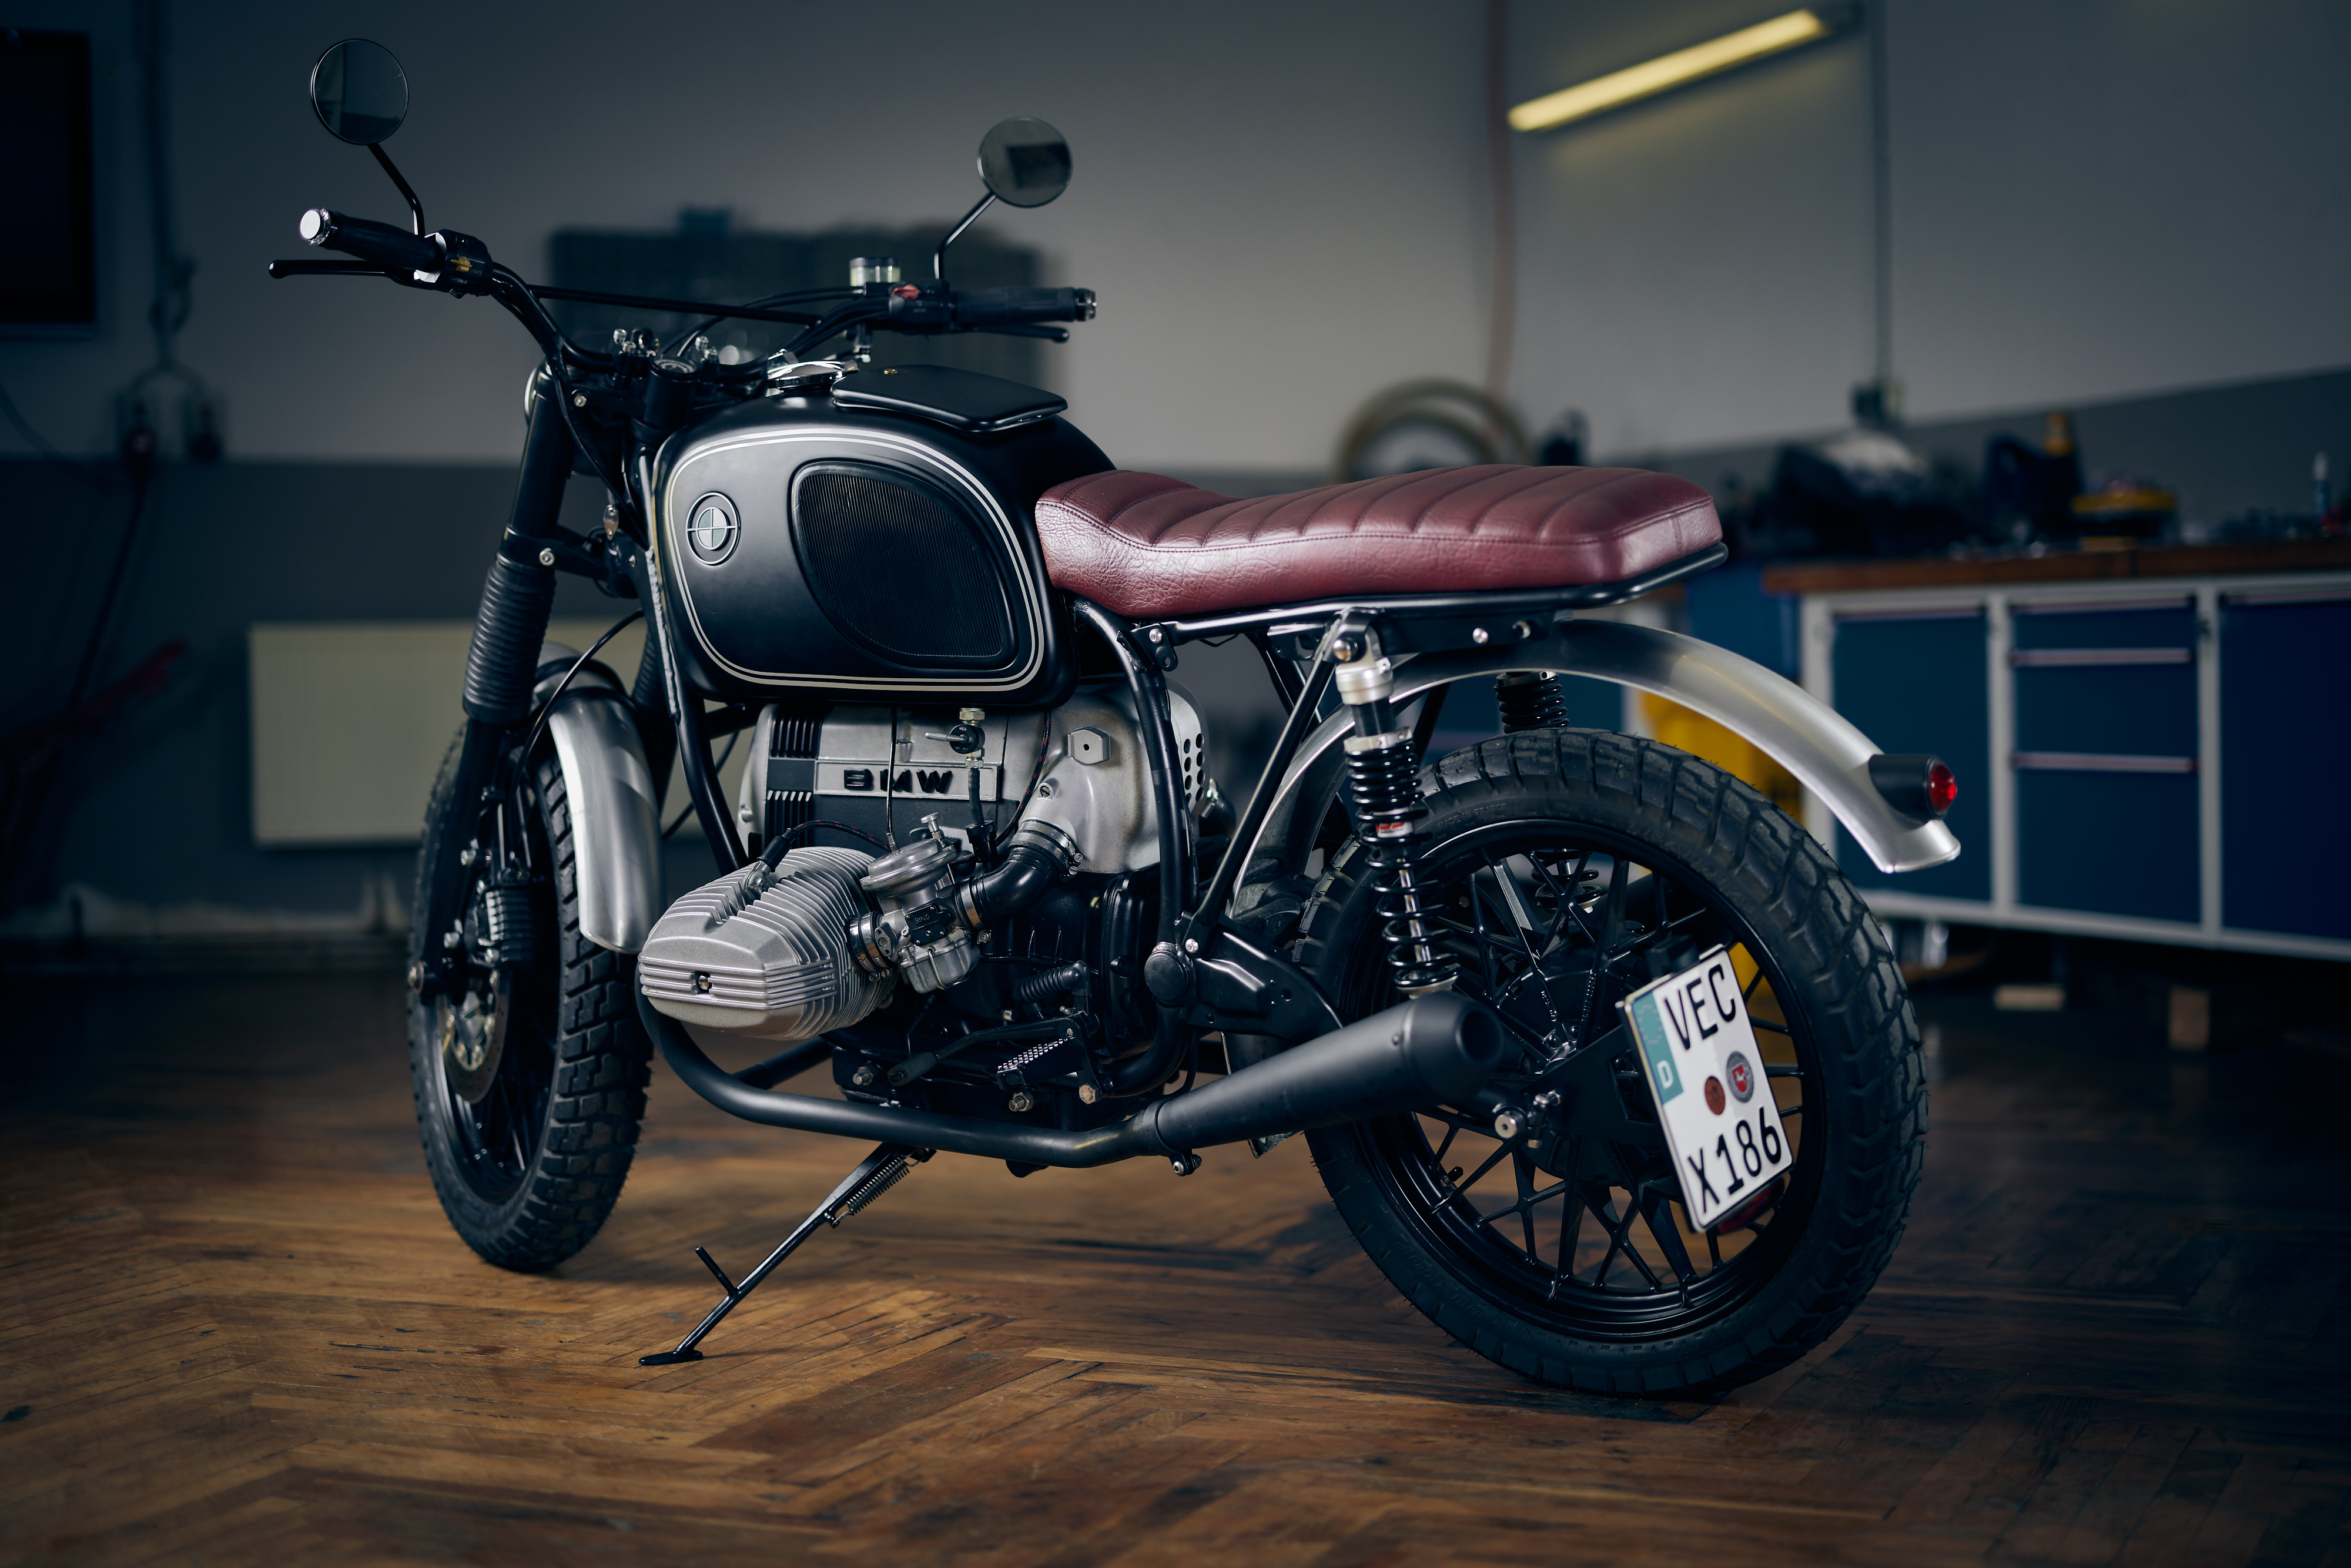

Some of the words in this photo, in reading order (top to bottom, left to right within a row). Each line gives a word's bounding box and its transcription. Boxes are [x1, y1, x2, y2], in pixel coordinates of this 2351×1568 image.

[844, 767, 952, 793] BMW
[1438, 815, 1461, 829] MADE
[1462, 810, 1471, 820] IN
[1474, 803, 1508, 816] FRANCE
[915, 914, 930, 924] BING
[1664, 964, 1736, 1050] VEC
[1657, 1060, 1673, 1089] D
[1687, 1107, 1781, 1213] X186
[1395, 1241, 1486, 1321] DUNLOP
